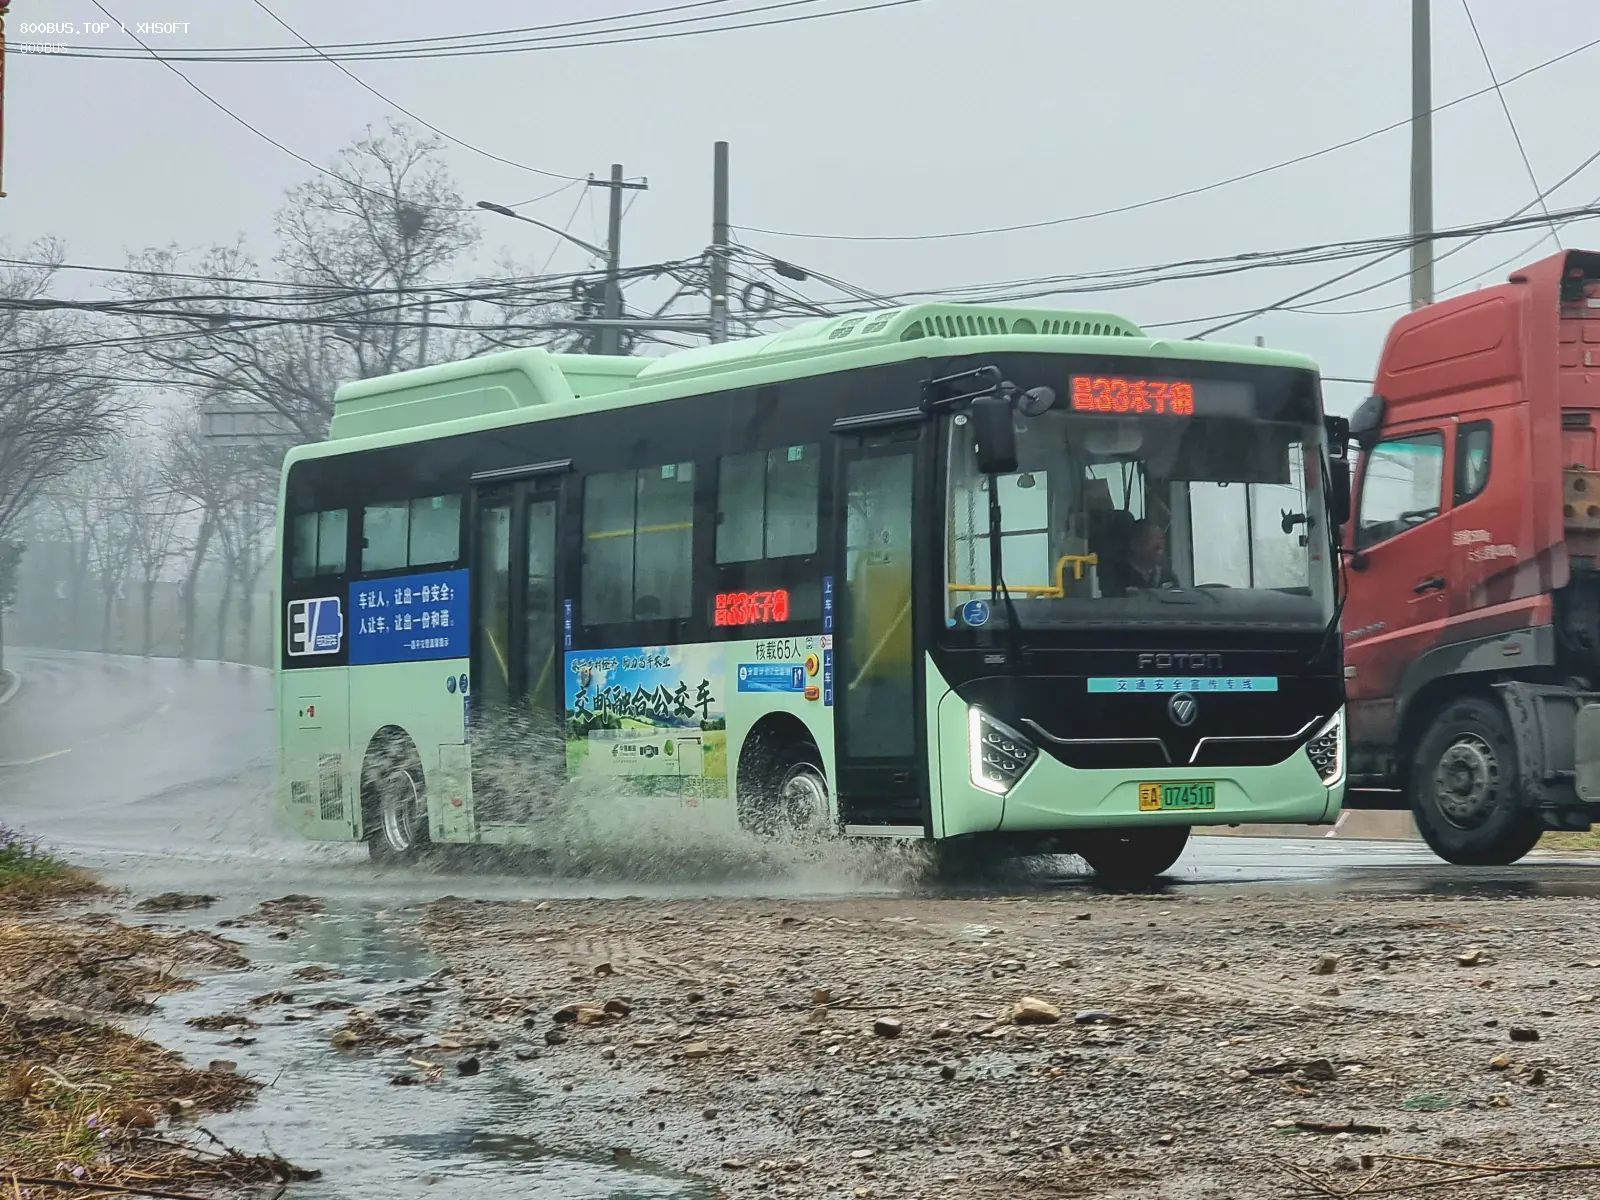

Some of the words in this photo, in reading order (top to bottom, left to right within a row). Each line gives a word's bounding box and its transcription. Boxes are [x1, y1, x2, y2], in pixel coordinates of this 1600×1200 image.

[756, 639, 801, 660] 核载65人
[1138, 653, 1222, 668] FOTON
[1116, 679, 1253, 691] 交通安全宣传专线
[573, 679, 716, 724] 交邮融合公交车
